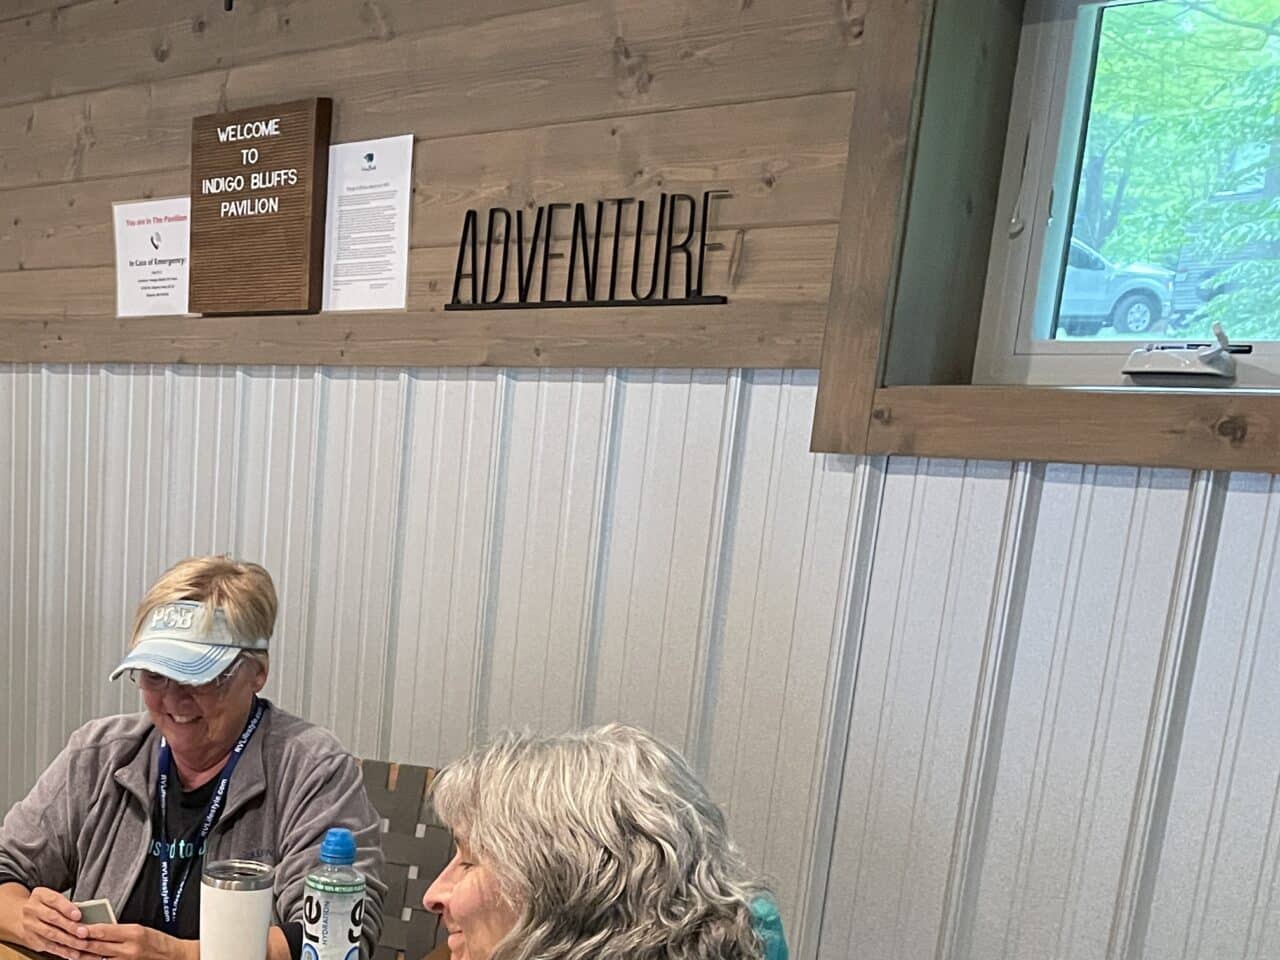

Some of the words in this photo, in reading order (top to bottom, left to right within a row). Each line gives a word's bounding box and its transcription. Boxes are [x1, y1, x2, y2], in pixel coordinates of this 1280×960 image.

[217, 118, 281, 142] WELCOME
[240, 148, 259, 165] TO
[202, 175, 245, 194] INDIGO
[250, 169, 298, 190] BLUFFS
[220, 197, 279, 218] PAVILION
[451, 189, 733, 306] ADVENTURE
[322, 901, 331, 946] HYDRATION
